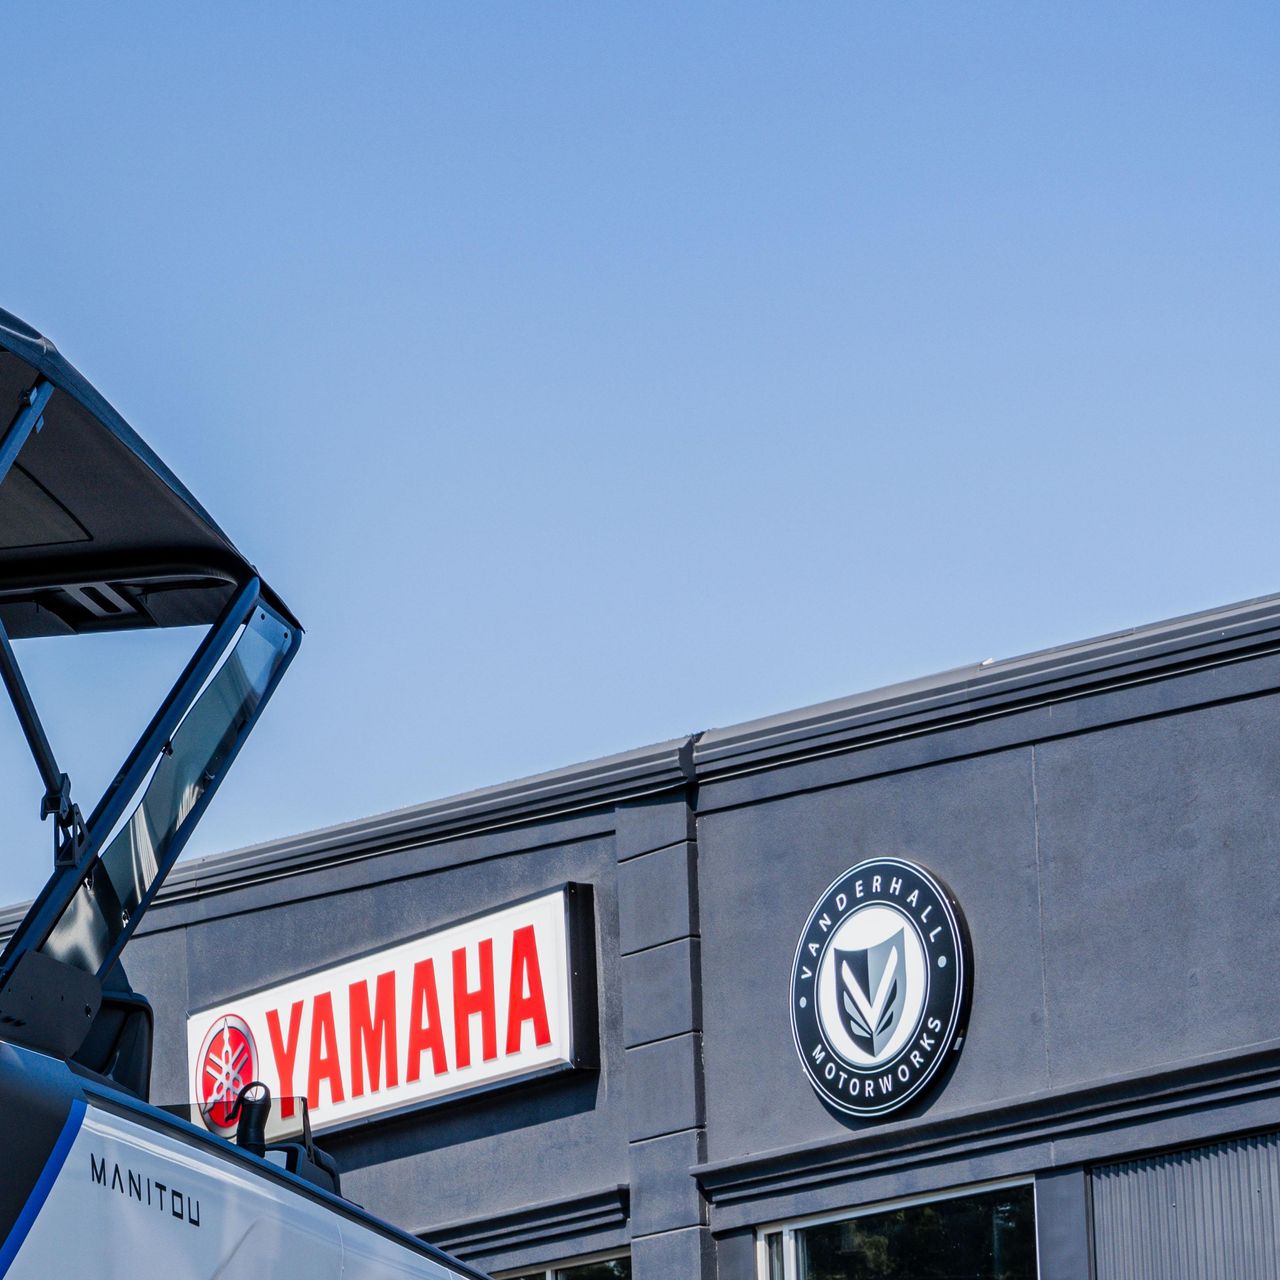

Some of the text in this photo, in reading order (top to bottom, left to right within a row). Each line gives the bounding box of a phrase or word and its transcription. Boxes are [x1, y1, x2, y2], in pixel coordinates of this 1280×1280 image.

[801, 875, 942, 980] VANDERHALL
[266, 924, 551, 1120] YAMAHA
[812, 1017, 941, 1097] MOTORWORKS
[90, 1152, 200, 1227] MANITOU
